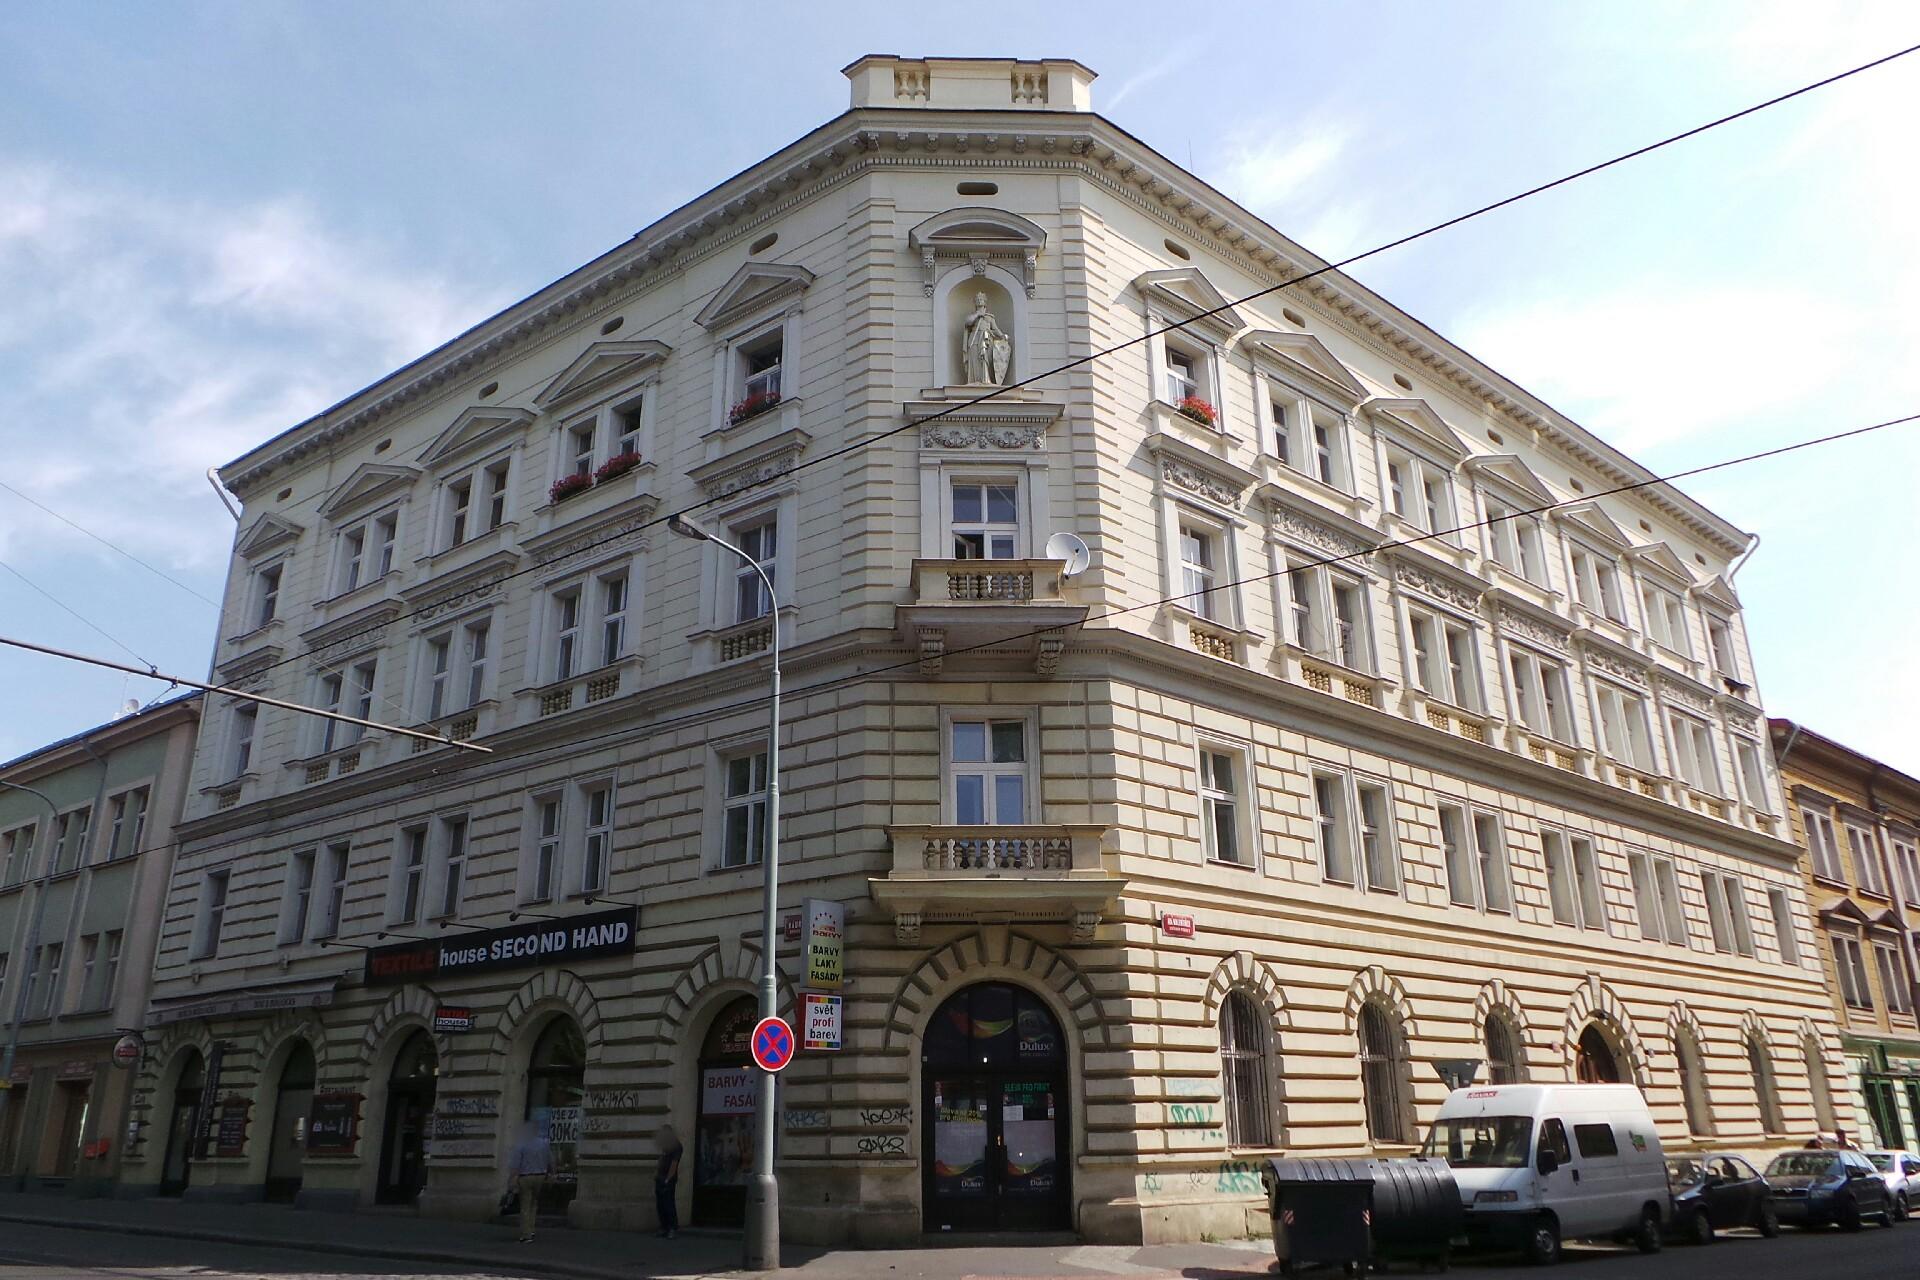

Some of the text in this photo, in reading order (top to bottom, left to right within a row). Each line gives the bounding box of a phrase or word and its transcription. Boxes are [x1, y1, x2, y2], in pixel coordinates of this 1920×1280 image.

[372, 922, 629, 976] TEXTILE house SECOND HAND
[812, 945, 840, 956] BARVY
[816, 958, 837, 969] LAKY
[811, 970, 840, 981] FASÁDY
[814, 1004, 834, 1015] svět
[812, 1017, 834, 1028] profi
[810, 1028, 837, 1039] barev
[1019, 1041, 1050, 1051] Dulux
[709, 1075, 747, 1088] BARVY
[724, 1093, 759, 1107] FASÁ
